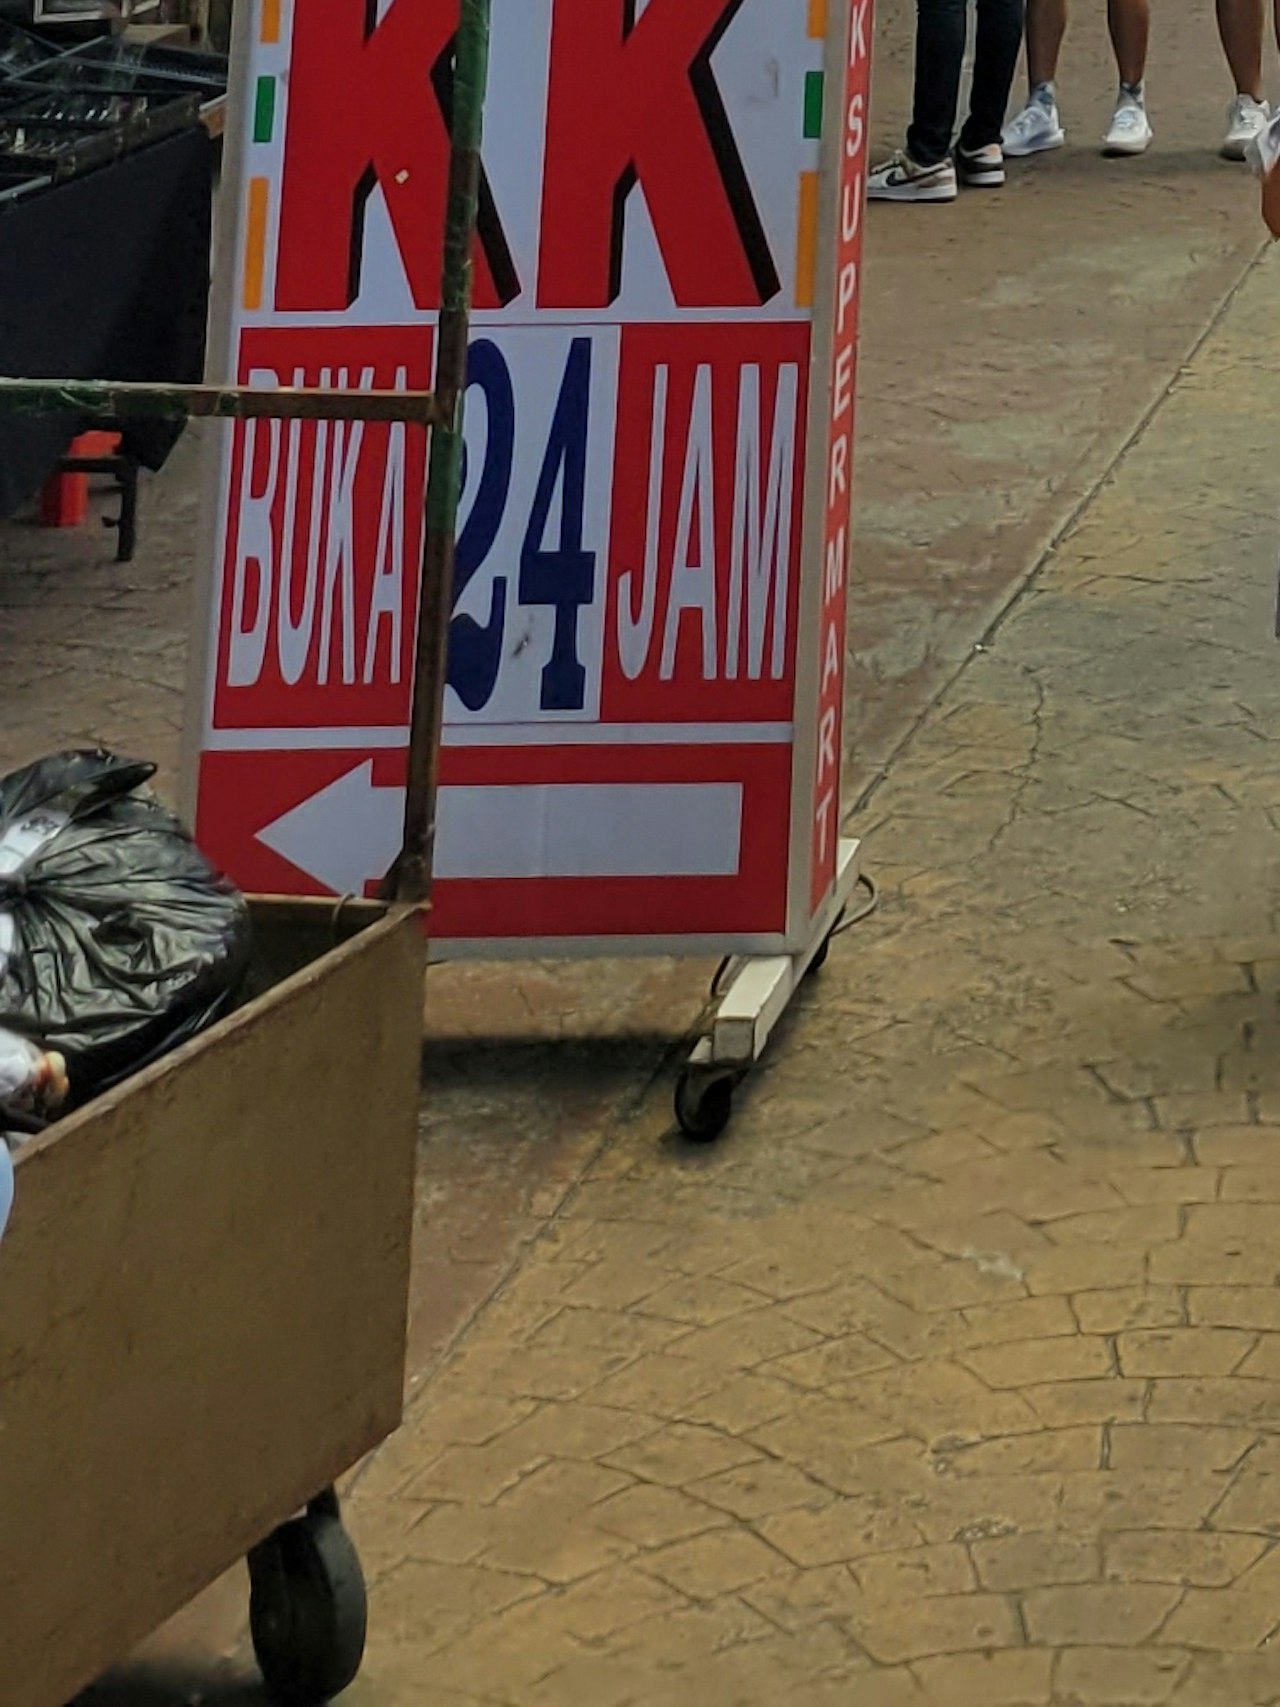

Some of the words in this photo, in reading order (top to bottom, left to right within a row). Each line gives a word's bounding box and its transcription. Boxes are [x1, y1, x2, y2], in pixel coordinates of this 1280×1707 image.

[225, 364, 409, 688] BUKA
[444, 336, 597, 714] 24
[616, 361, 800, 682] JAM
[815, 99, 864, 865] SUPERMART
